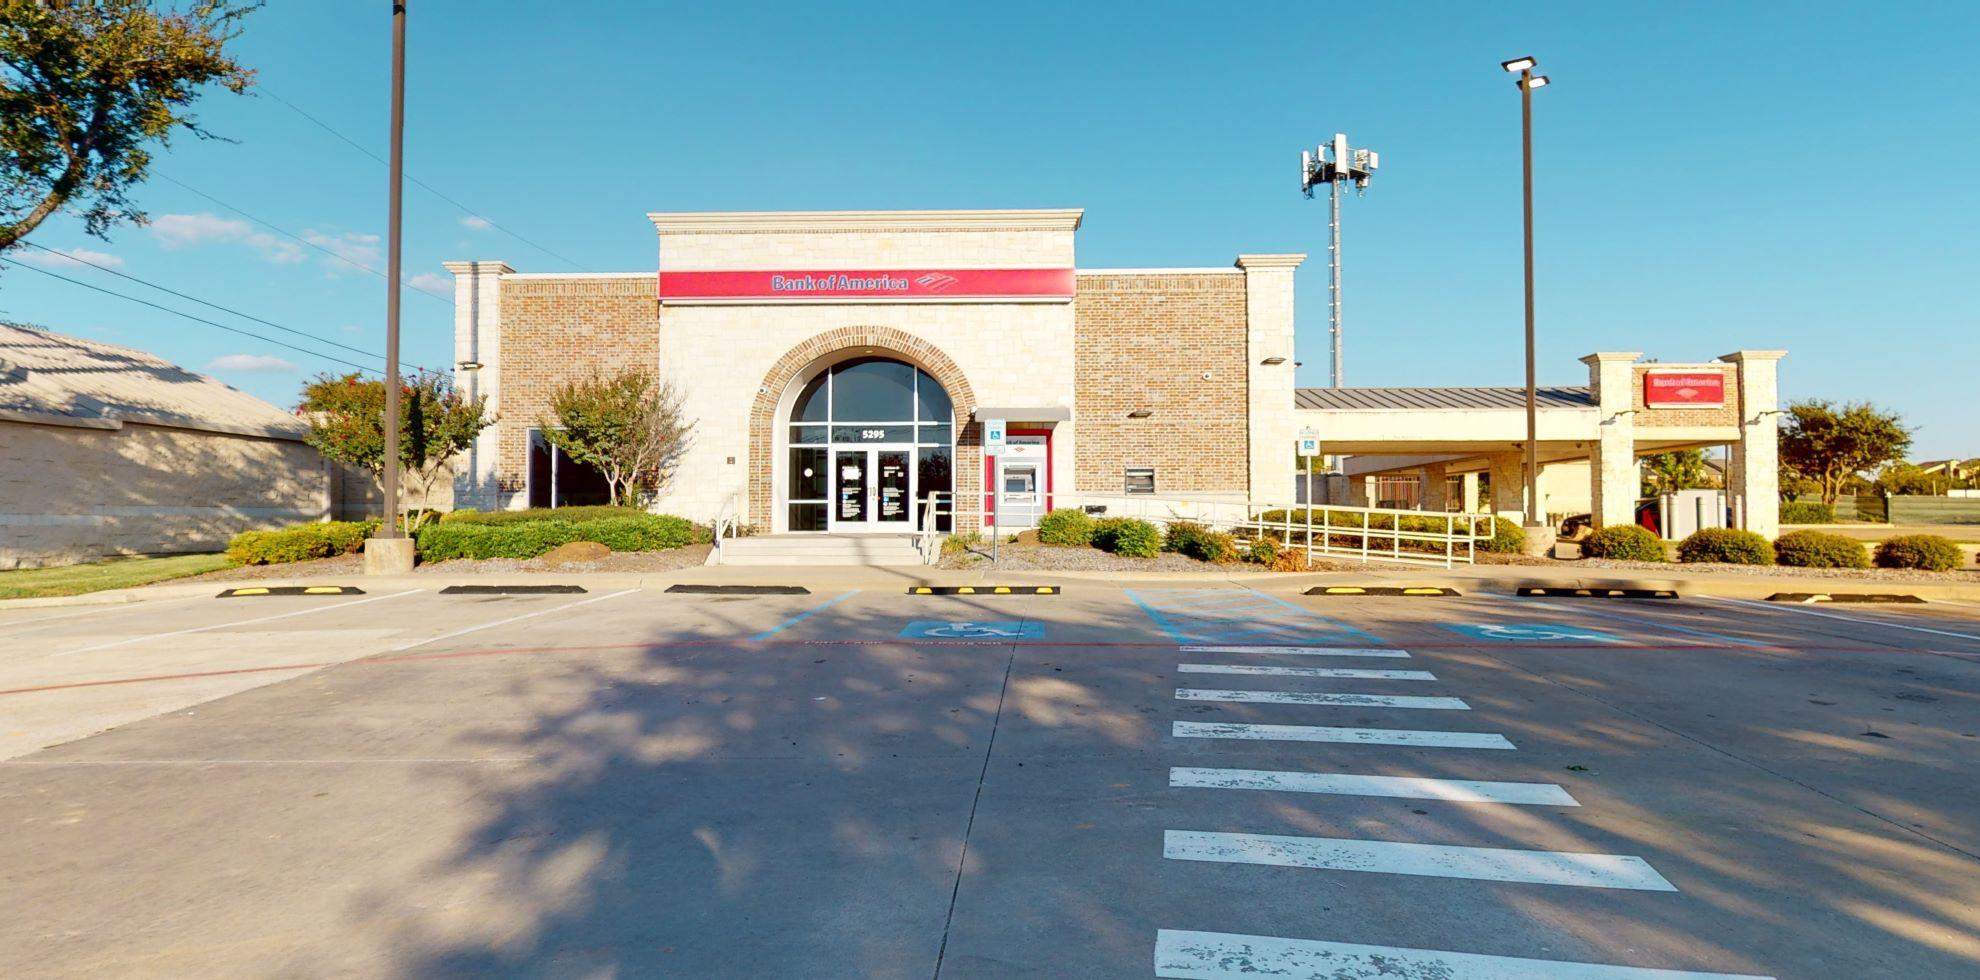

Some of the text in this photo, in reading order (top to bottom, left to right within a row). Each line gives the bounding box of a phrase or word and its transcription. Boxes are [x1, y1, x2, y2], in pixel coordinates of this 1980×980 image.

[772, 274, 909, 291] Bank of America
[862, 430, 885, 439] 5295
